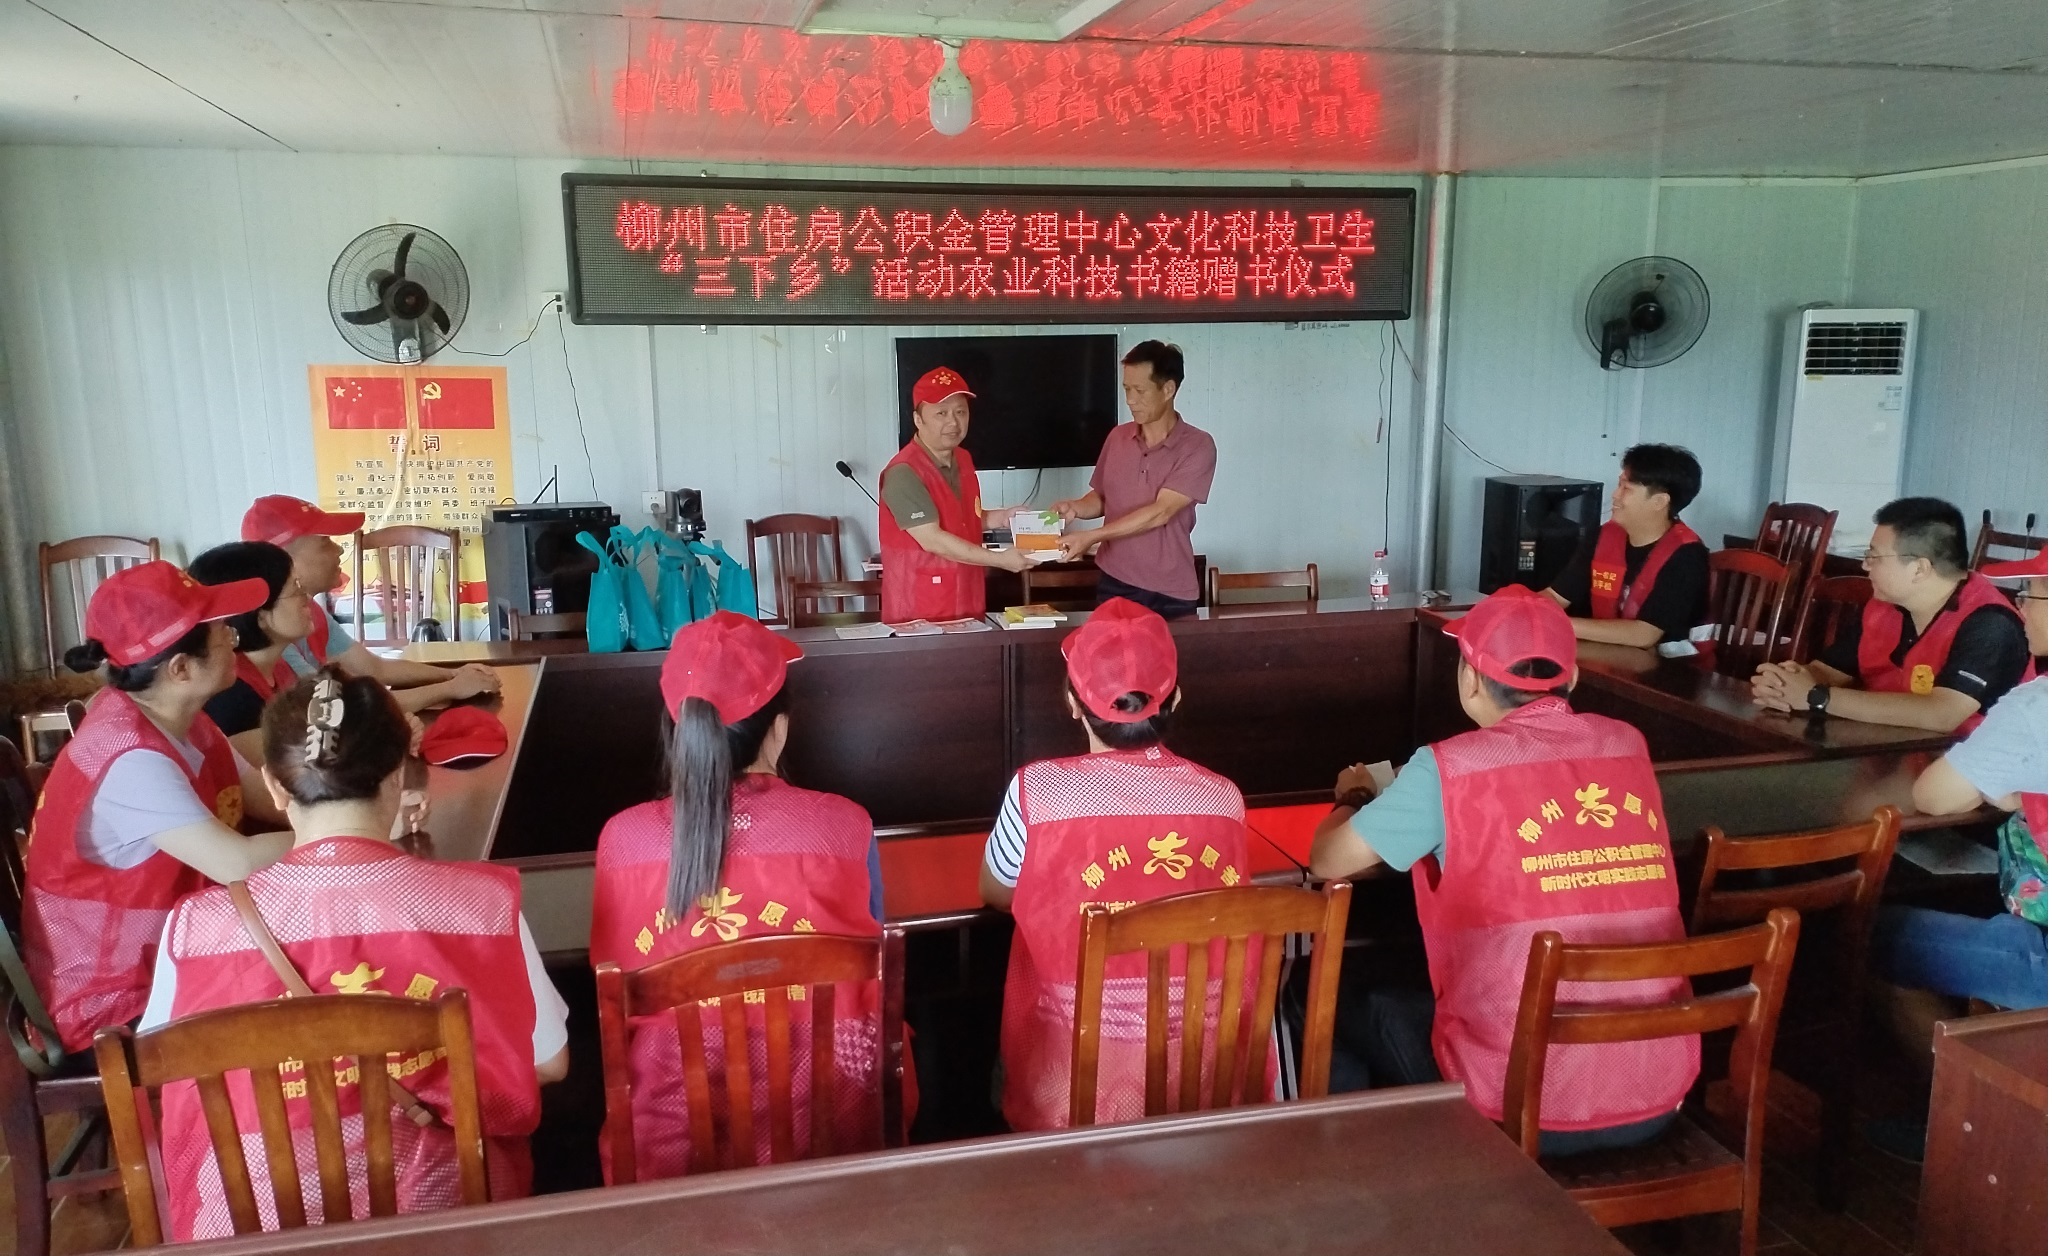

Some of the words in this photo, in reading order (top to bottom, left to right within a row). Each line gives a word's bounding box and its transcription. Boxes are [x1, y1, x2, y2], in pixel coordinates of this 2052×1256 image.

[615, 200, 1375, 254] 柳州市住房公积金管理中心文化科技卫生
